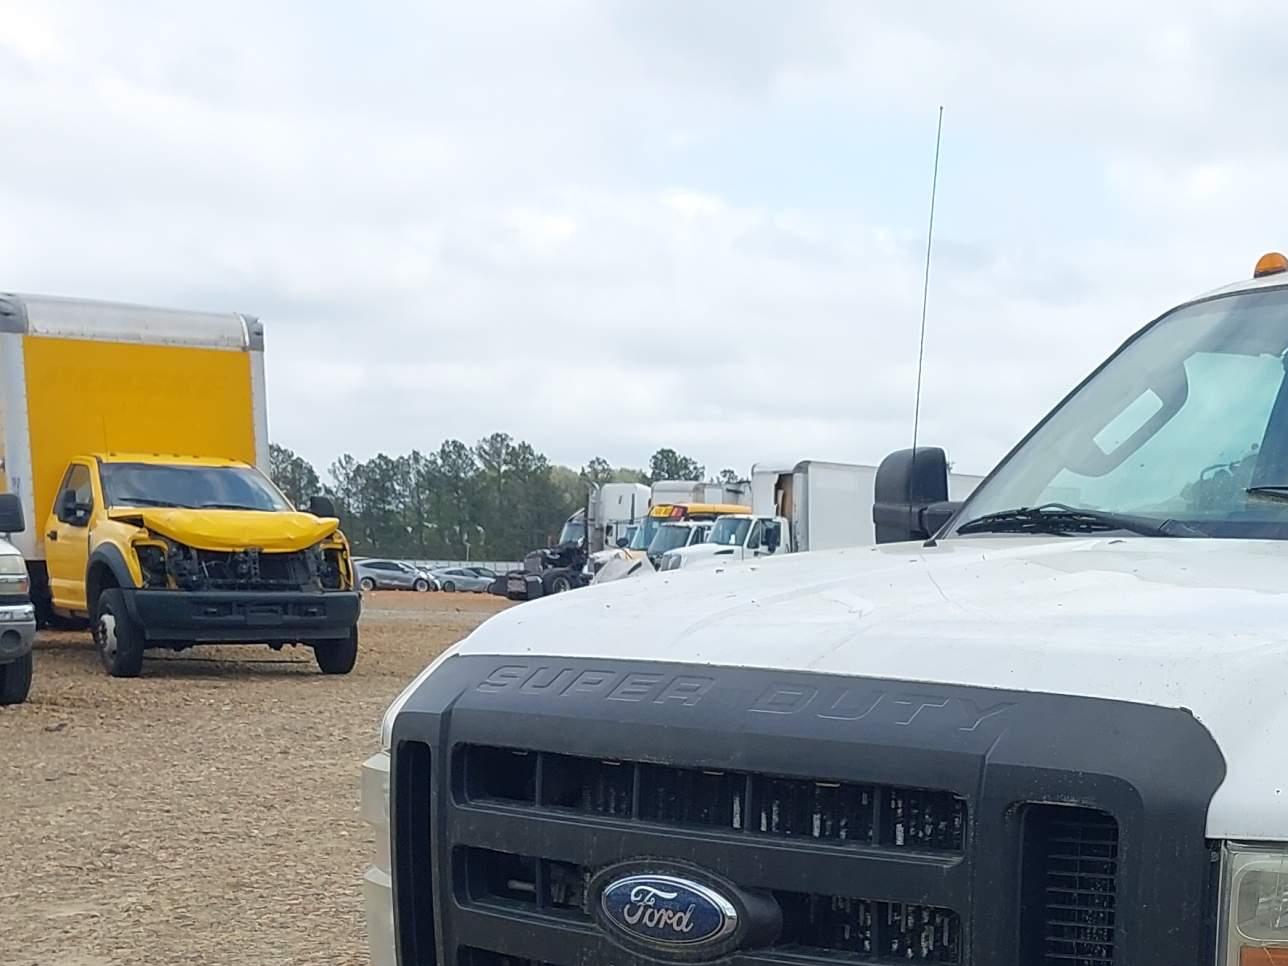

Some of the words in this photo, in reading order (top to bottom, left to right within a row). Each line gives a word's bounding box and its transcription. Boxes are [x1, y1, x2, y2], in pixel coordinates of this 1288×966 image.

[476, 664, 716, 707] SUPER
[746, 681, 1018, 731] DUTY
[623, 885, 696, 933] Ford
